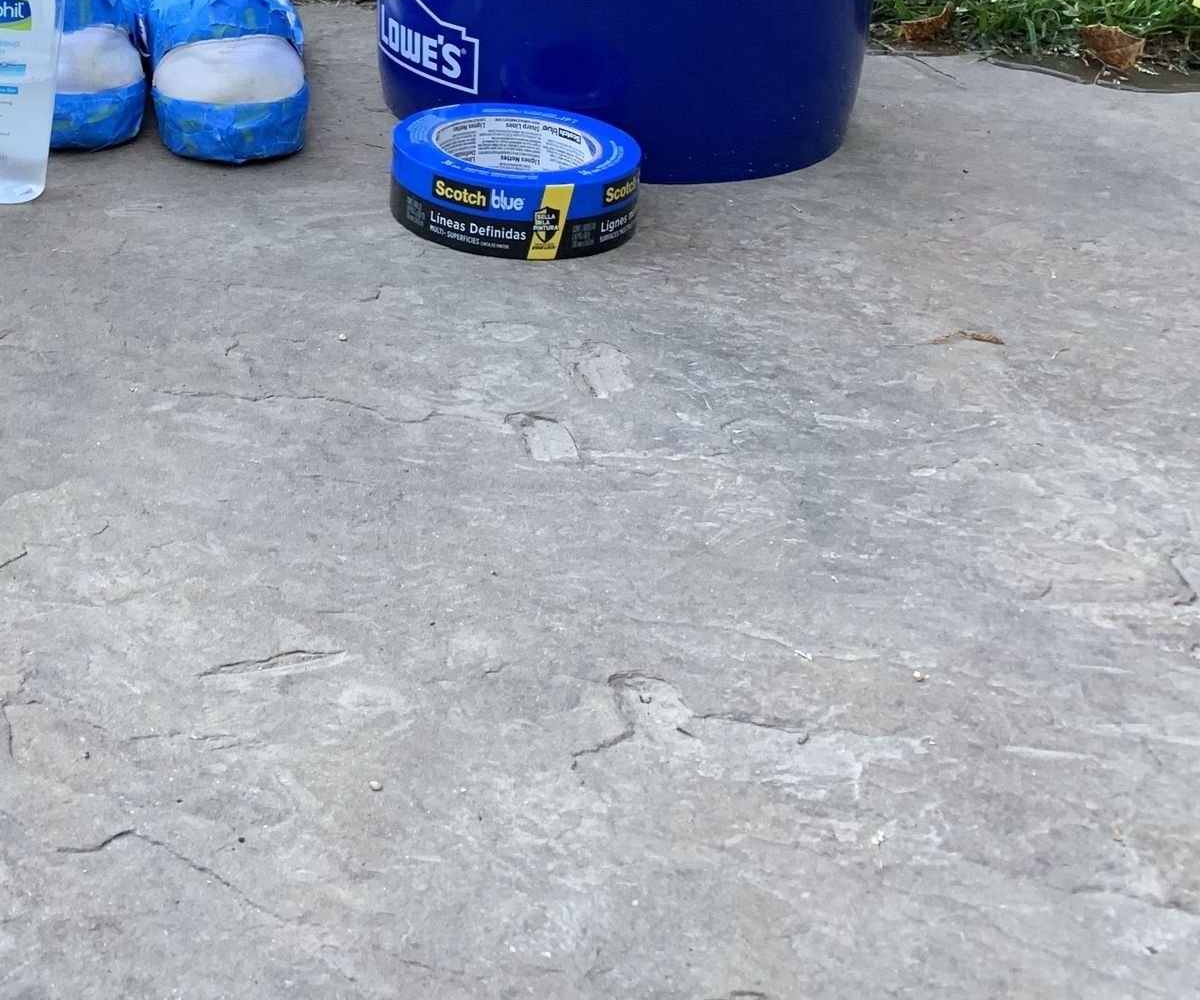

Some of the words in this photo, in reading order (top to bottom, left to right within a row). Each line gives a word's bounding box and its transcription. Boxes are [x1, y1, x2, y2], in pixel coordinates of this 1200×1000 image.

[381, 17, 461, 79] LOWE'S
[435, 180, 486, 207] Scotch
[491, 188, 524, 211] blue
[430, 210, 465, 232] Líneas
[470, 222, 527, 240] Definidas
[447, 231, 480, 246] SUPERFICIES
[601, 214, 628, 233] Lignes
